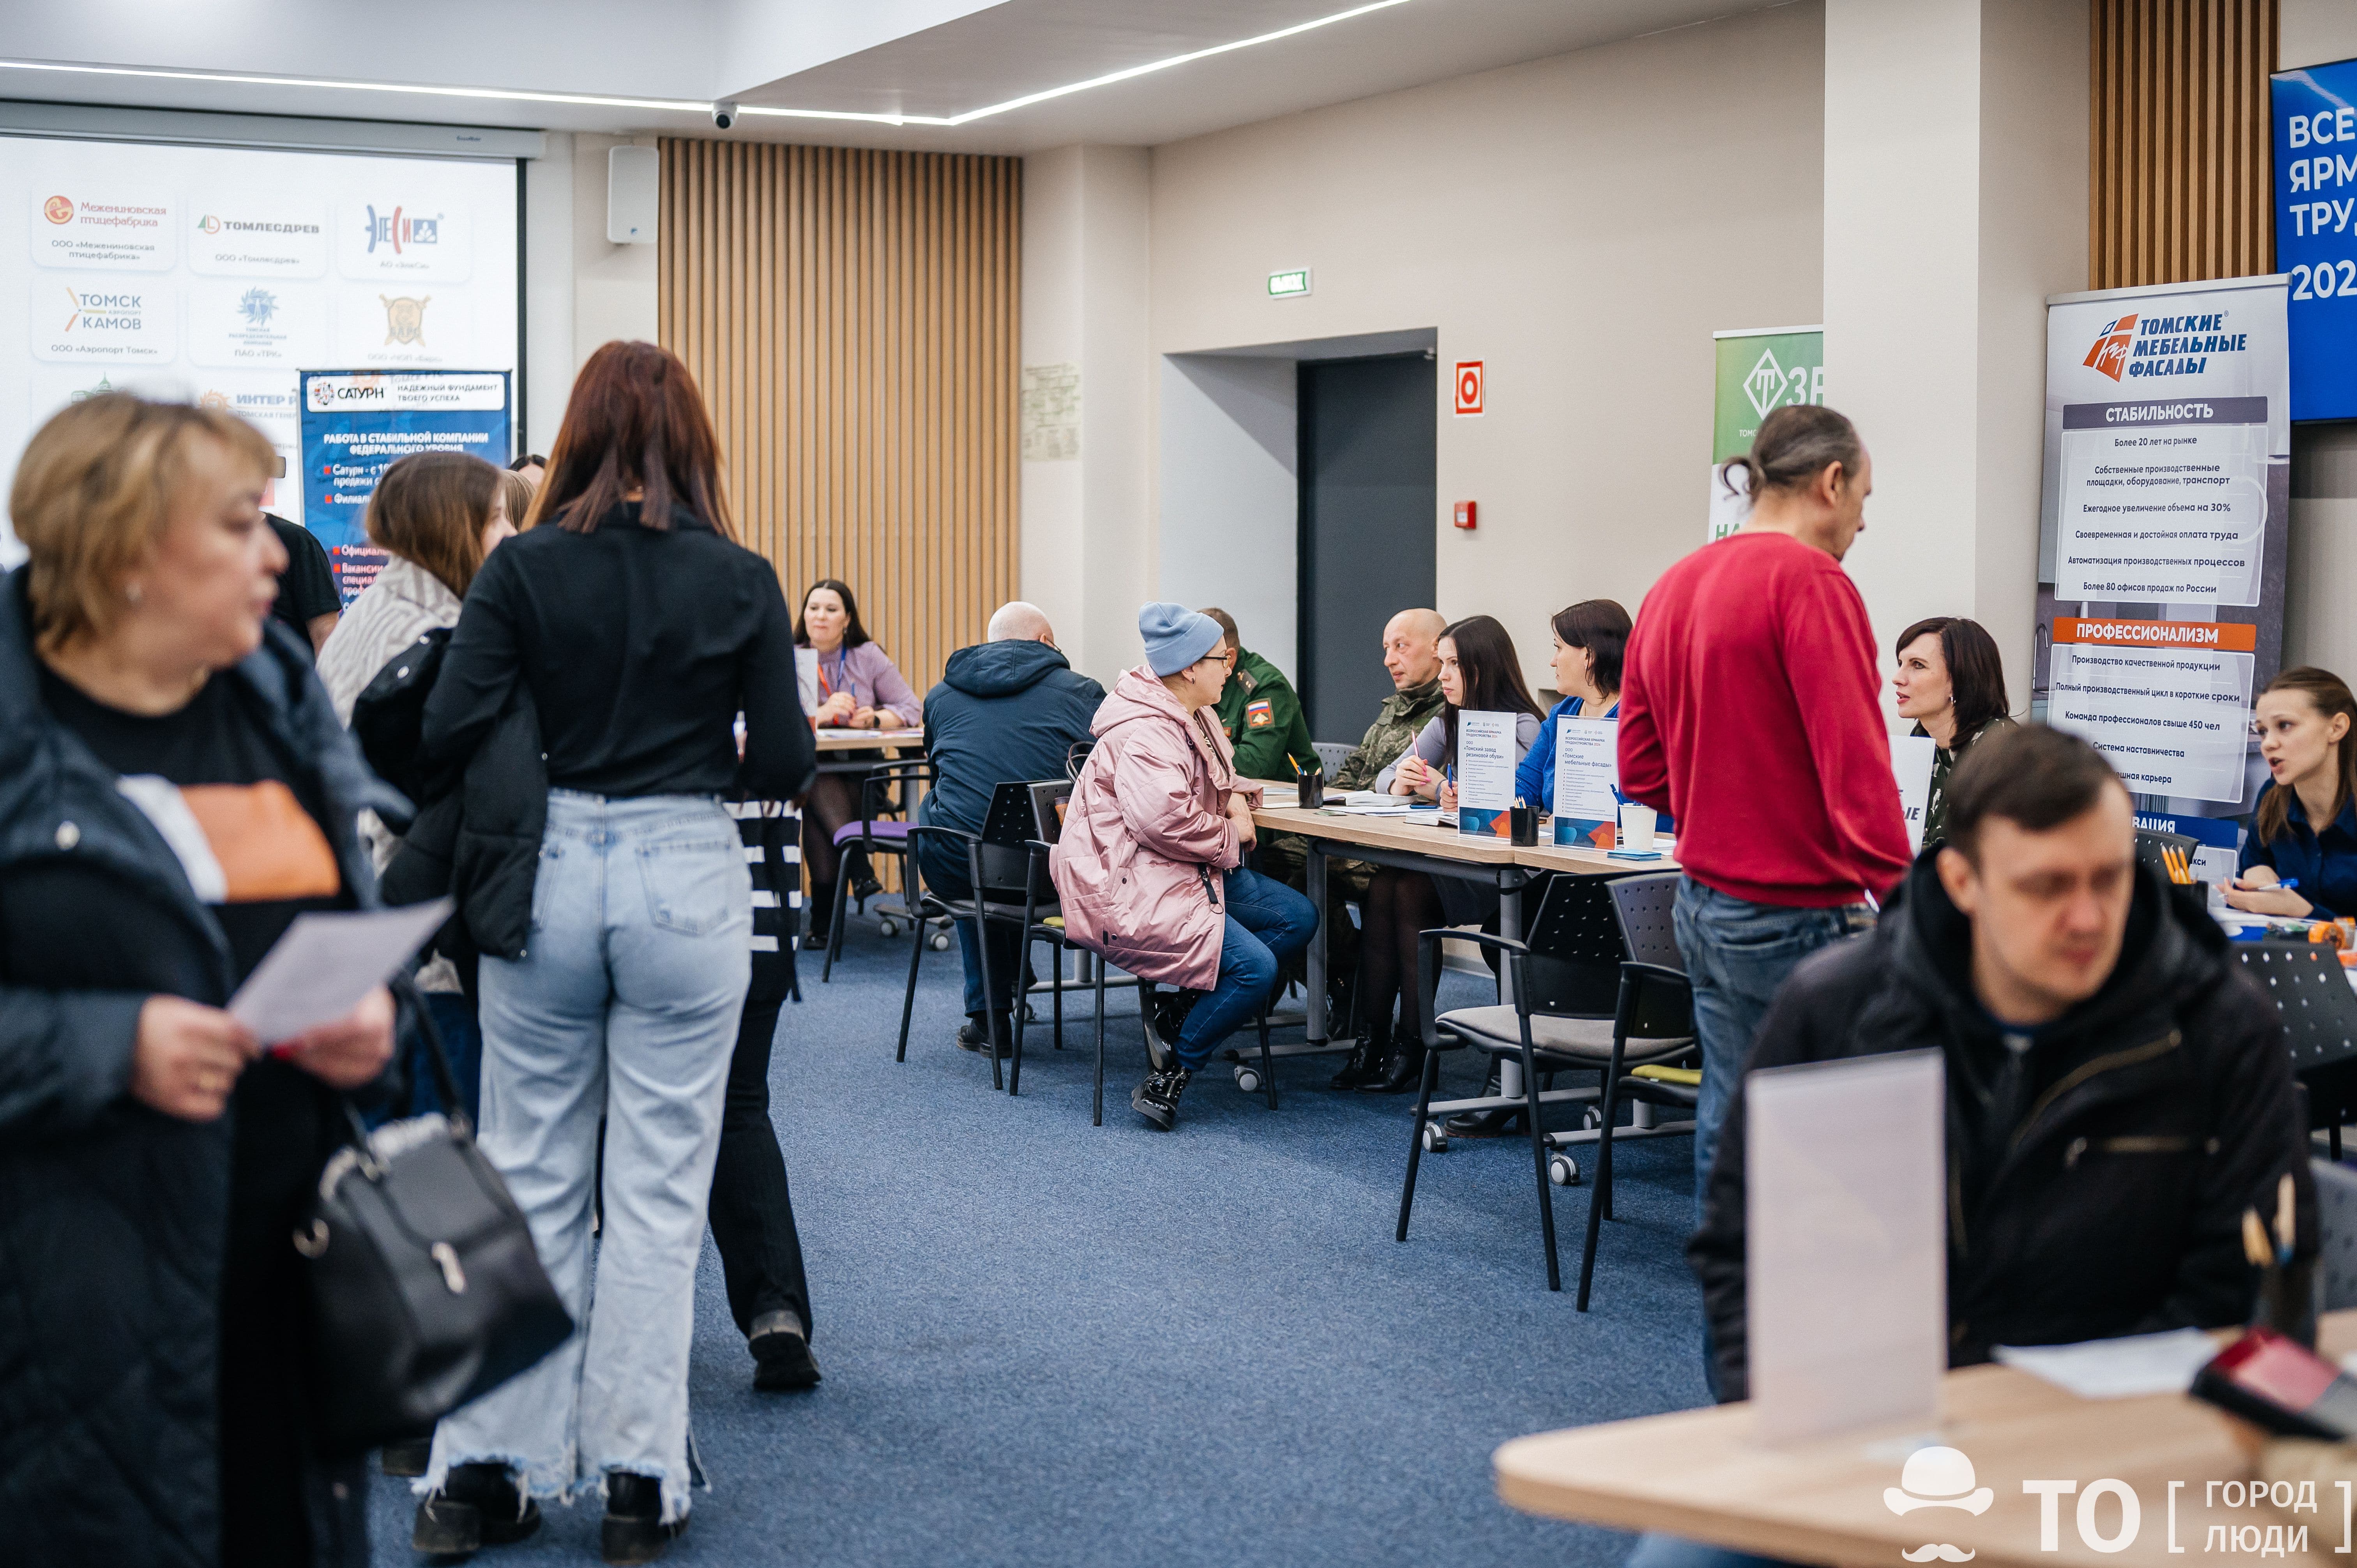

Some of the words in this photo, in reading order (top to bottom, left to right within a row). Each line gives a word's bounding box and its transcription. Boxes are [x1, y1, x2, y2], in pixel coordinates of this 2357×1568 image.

[81, 202, 166, 215] Межениновская
[81, 215, 158, 228] птицефабрика
[2290, 198, 2357, 236] ТРУ
[224, 221, 319, 233] ТОМЛЕСДРЕВ
[80, 294, 141, 307] ТОМСК
[83, 317, 141, 329] КАМОВ
[2141, 314, 2223, 335] ТОМСКИЕ
[76, 345, 123, 354] «Аэропорт
[127, 346, 157, 354] Томск»
[2133, 334, 2247, 357] МЕБЕЛЬНЫЕ
[2129, 357, 2207, 377] ФАСАДЫ
[337, 387, 384, 399] САТУРН
[398, 384, 445, 393] НАДЕЖНЫЙ
[448, 384, 498, 392] ФУНДАМЕНТ
[237, 394, 285, 404] ИНТЕР
[2105, 403, 2214, 422] СТАБИЛЬНОСТЬ
[324, 434, 359, 444] РАБОТА
[360, 434, 367, 444] В
[368, 431, 431, 443] СТАБИЛЬНОЙ
[433, 433, 489, 443] КОМПАНИИ
[2115, 438, 2136, 447] Более
[2173, 437, 2197, 447] рынке
[349, 443, 424, 456] ФЕДЕРАЛЬНОГО
[333, 464, 364, 477] Сатурн
[2095, 465, 2143, 474] Собственные
[2145, 464, 2220, 474] производственные
[334, 477, 373, 489] продажи
[2087, 477, 2124, 487] площадки,
[2127, 476, 2181, 487] оборудование,
[2183, 477, 2230, 486] транспорт
[2083, 505, 2120, 513] Ежегодное
[2122, 504, 2166, 514] увеличение
[2168, 503, 2195, 512] объема
[2210, 503, 2231, 512] 30%
[2076, 530, 2131, 540] Своевременная
[2140, 530, 2177, 540] достойная
[2210, 532, 2239, 541] труда
[2068, 556, 2122, 566] Автоматизация
[2124, 557, 2191, 567] производственных
[2194, 559, 2245, 567] процессов
[2083, 582, 2104, 591] Более
[2106, 582, 2115, 591] 80
[2117, 583, 2145, 592] офисов
[2147, 584, 2174, 593] продаж
[2186, 584, 2216, 593] России
[2076, 623, 2219, 643] ПРОФЕССИОНАЛИЗМ
[2072, 655, 2123, 666] Производство
[2125, 658, 2174, 668] качественной
[2176, 662, 2220, 671] продукции
[2056, 682, 2081, 692] Полный
[2083, 685, 2150, 696] производственный
[2152, 690, 2168, 698] цикл
[2175, 692, 2209, 700] короткие
[2212, 694, 2240, 703] сроки
[2065, 711, 2097, 722] Команда
[2099, 714, 2161, 726] профессионалов
[2189, 720, 2202, 729] 450
[2204, 722, 2220, 731] чел
[2093, 742, 2124, 752] Система
[2126, 745, 2184, 758] наставничества
[2141, 773, 2171, 784] карьера
